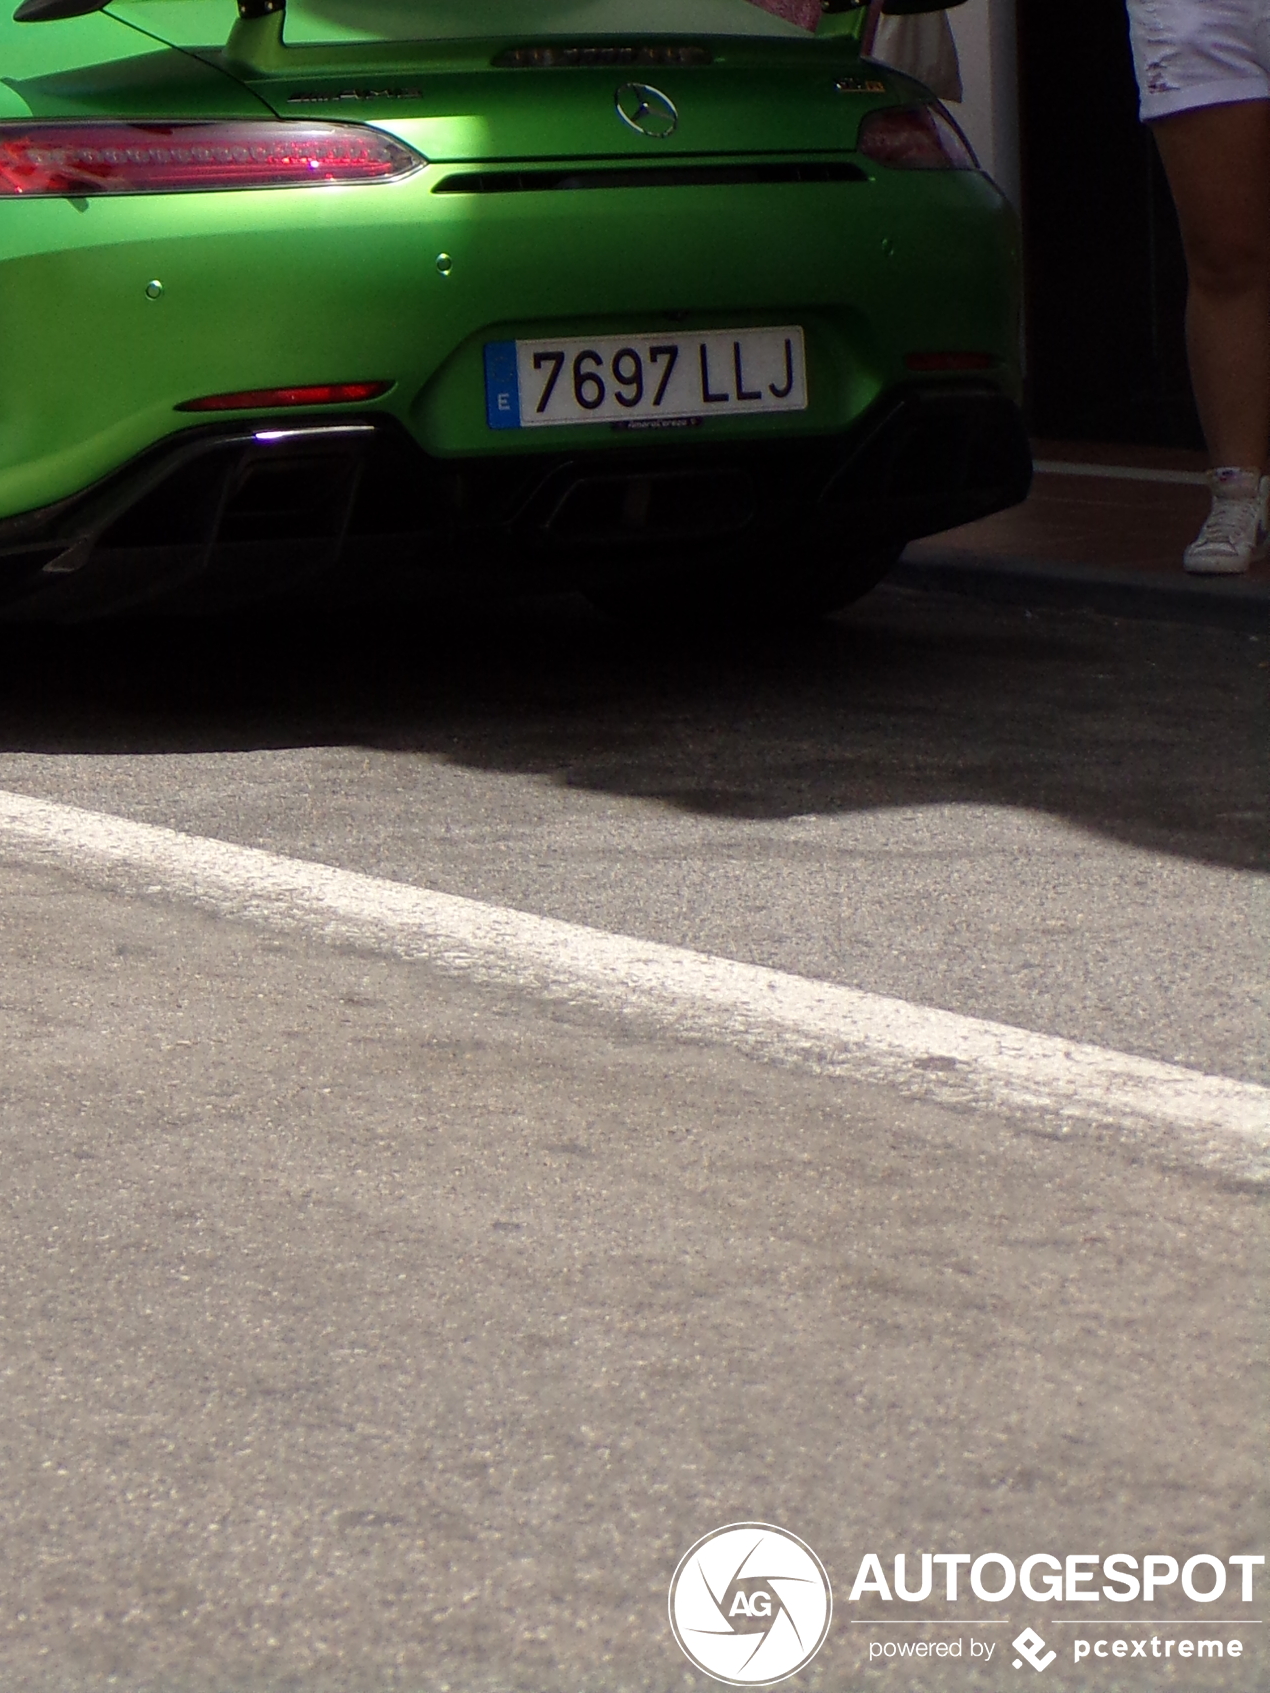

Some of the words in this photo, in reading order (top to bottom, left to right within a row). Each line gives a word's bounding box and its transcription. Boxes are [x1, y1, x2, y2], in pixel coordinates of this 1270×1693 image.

[533, 345, 679, 413] 7697
[699, 338, 793, 403] LLJ
[497, 393, 511, 411] E
